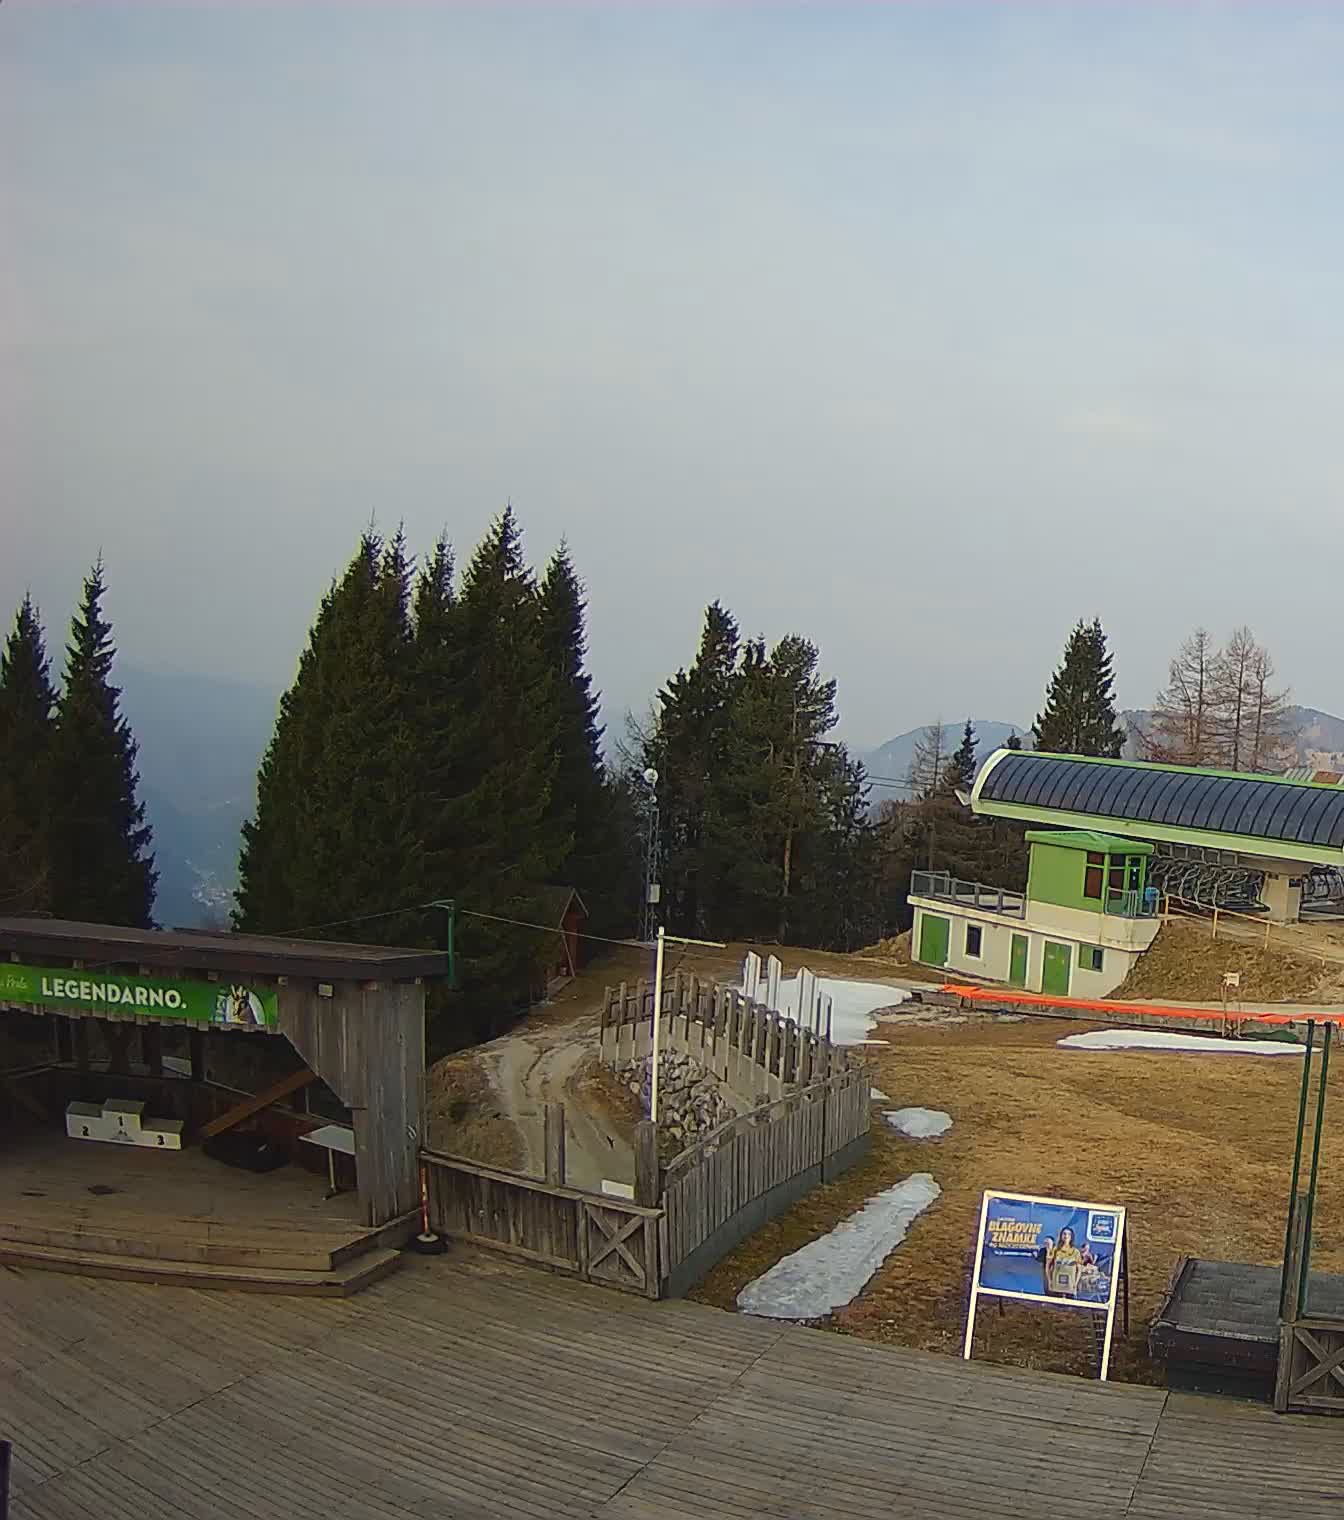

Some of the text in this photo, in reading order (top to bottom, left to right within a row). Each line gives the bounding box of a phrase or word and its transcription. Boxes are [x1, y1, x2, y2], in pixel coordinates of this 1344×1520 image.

[41, 977, 187, 1009] LEGENDARNO.
[118, 1116, 124, 1127] 1
[82, 1126, 89, 1136] 2
[157, 1135, 164, 1145] 3
[991, 1231, 1038, 1243] ZNAMKE
